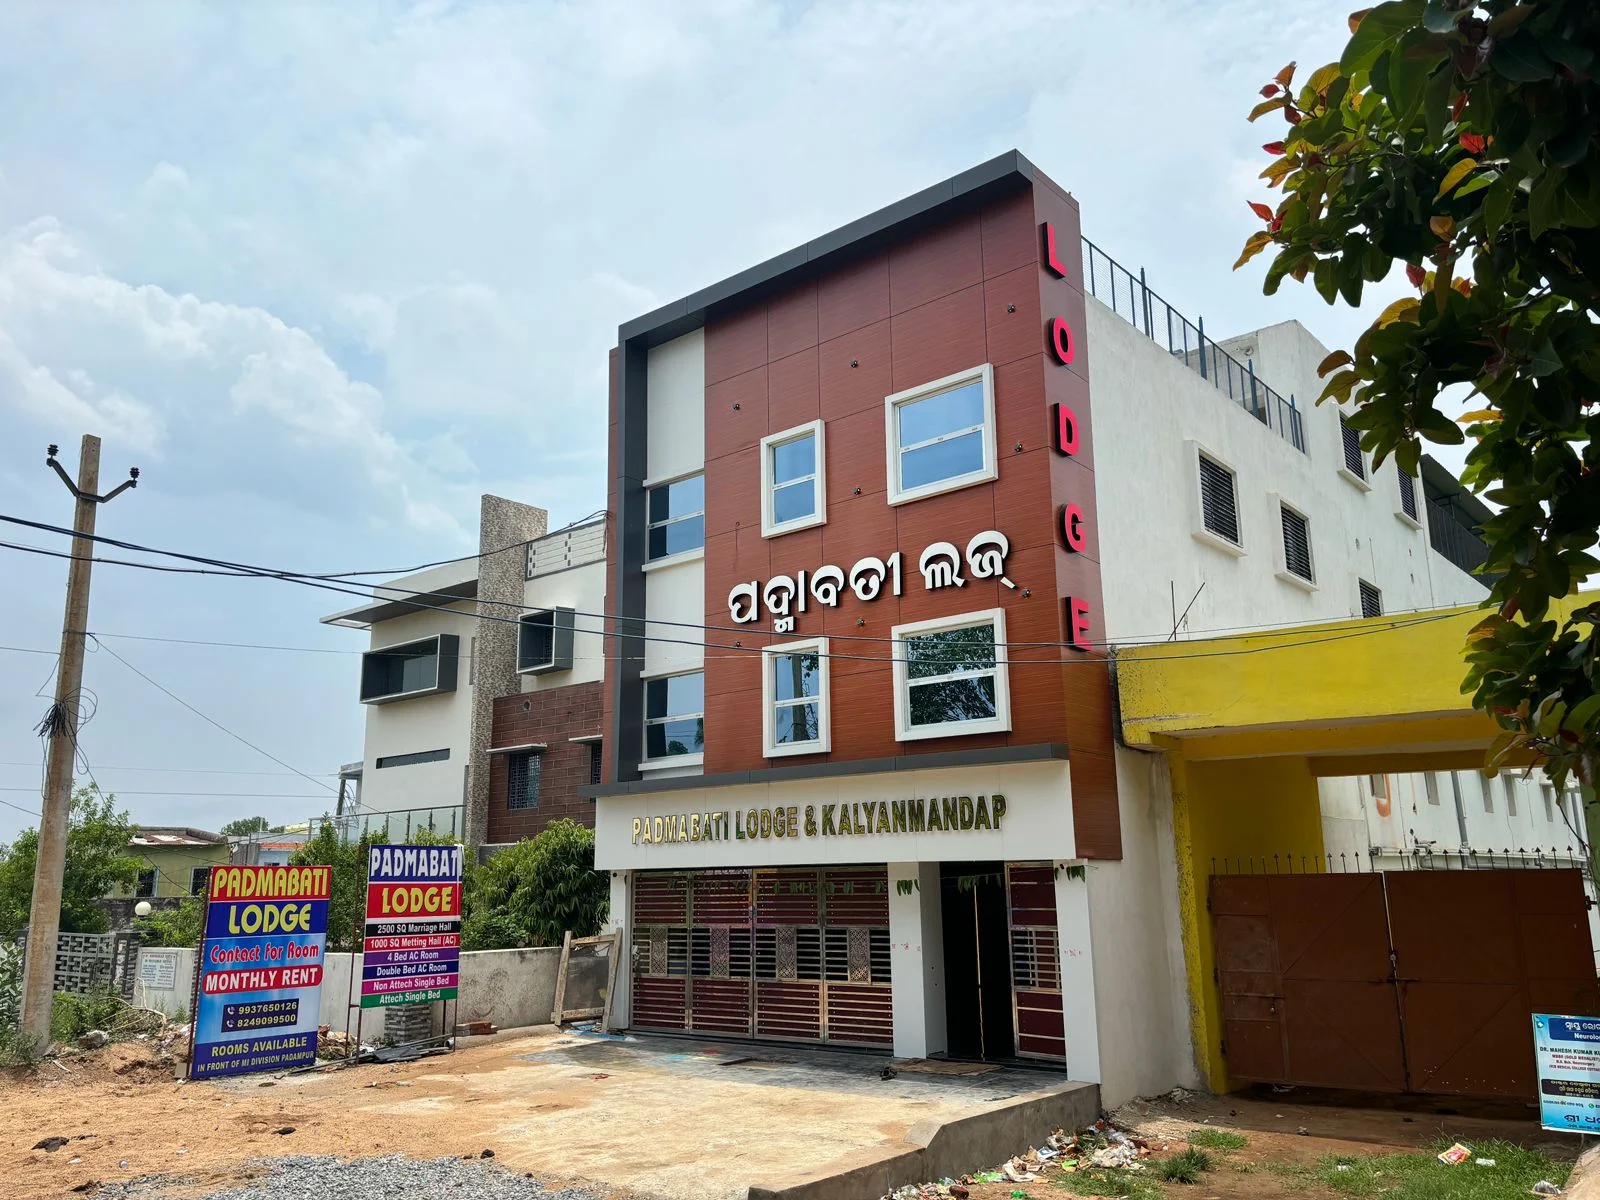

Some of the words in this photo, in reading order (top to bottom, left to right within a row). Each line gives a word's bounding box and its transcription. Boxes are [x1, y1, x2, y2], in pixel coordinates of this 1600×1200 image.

[1042, 221, 1092, 652] LODGE
[631, 811, 729, 845] PADMABATI
[735, 806, 799, 840] LODGE
[804, 805, 818, 837] &
[821, 794, 1008, 837] KALYANMANDAP
[213, 868, 328, 897] PADMABATI
[382, 886, 453, 914] LODGE
[228, 903, 311, 934] LODGE
[377, 925, 395, 934] 2500
[396, 924, 407, 934] SQ
[408, 923, 437, 934] Marriage
[439, 922, 452, 931] Hall
[370, 939, 388, 949] 1000
[389, 938, 400, 948] SQ
[401, 937, 427, 948] Metting
[428, 936, 441, 945] Hall
[442, 935, 457, 946] (AC)
[210, 945, 260, 964] Contact
[287, 941, 319, 959] Room
[387, 953, 393, 961] 4
[394, 952, 408, 961] Bed
[409, 952, 419, 960] AC
[420, 951, 439, 960] Room
[376, 966, 401, 976] Double
[403, 965, 416, 974] Bed
[417, 964, 428, 973] AC
[429, 962, 447, 971] Room
[206, 970, 277, 992] MONTHLY
[282, 968, 318, 986] RENT
[373, 981, 388, 991] Non
[389, 979, 413, 989] Attech
[414, 977, 435, 989] Single
[436, 976, 449, 985] Bed
[379, 993, 403, 1004] Attech
[404, 991, 427, 1003] Single
[427, 989, 441, 999] Bed
[238, 1002, 297, 1015] 9937650126
[237, 1015, 296, 1027] 8249099500
[1574, 1032, 1600, 1041] Neurolo
[211, 1043, 249, 1057] ROOMS
[252, 1037, 308, 1052] AVAILABLE
[198, 1064, 205, 1072] IN
[207, 1061, 229, 1071] FRONT
[231, 1060, 240, 1068] OF
[251, 1055, 280, 1065] DIVISION
[281, 1051, 314, 1062] PADAMPUR
